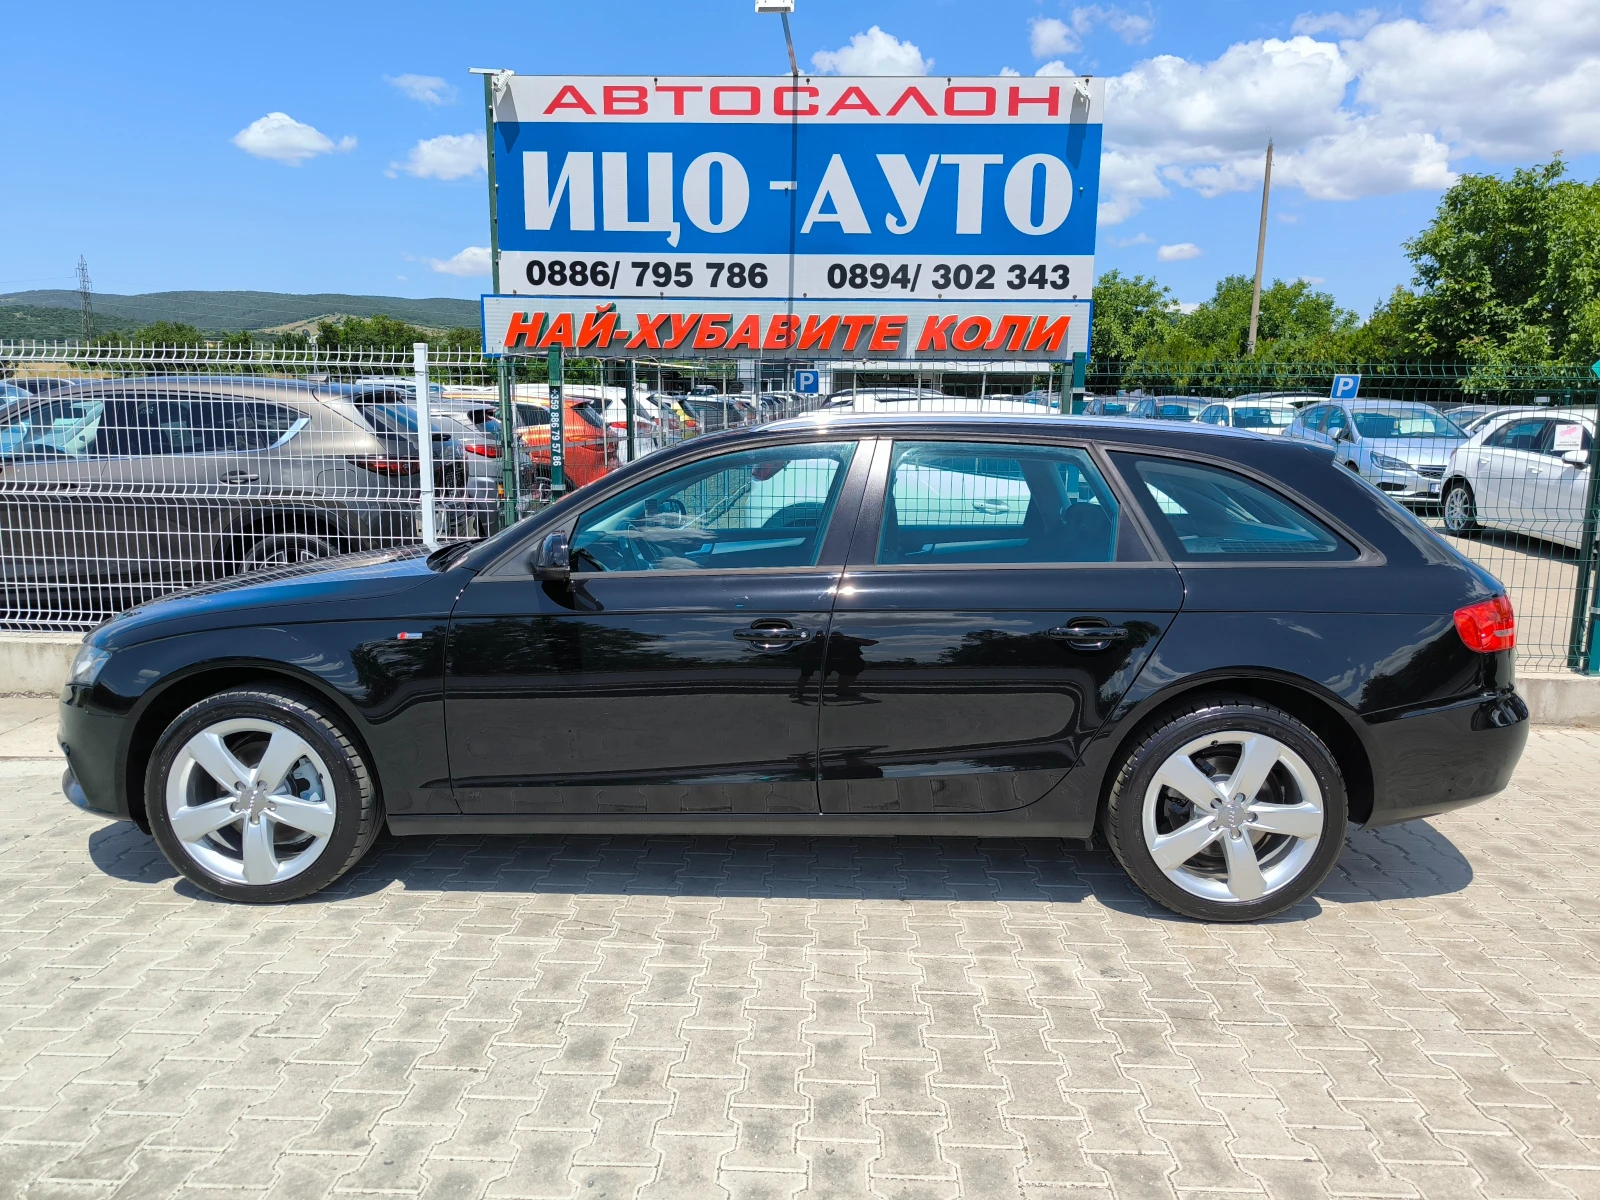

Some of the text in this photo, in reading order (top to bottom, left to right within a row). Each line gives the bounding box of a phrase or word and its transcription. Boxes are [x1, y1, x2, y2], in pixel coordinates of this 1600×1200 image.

[543, 85, 1060, 117] АВТОСАЛОН
[526, 259, 768, 290] 0886/ 795 786
[827, 263, 1070, 292] 0894/ 302 343
[503, 303, 1071, 352] НАЙ-ХУБАВИТЕ КОЛИ
[800, 372, 814, 391] P
[1336, 377, 1354, 397] P
[550, 412, 560, 428] 886
[551, 430, 560, 441] 79
[552, 443, 561, 454] 57
[552, 455, 562, 467] 86
